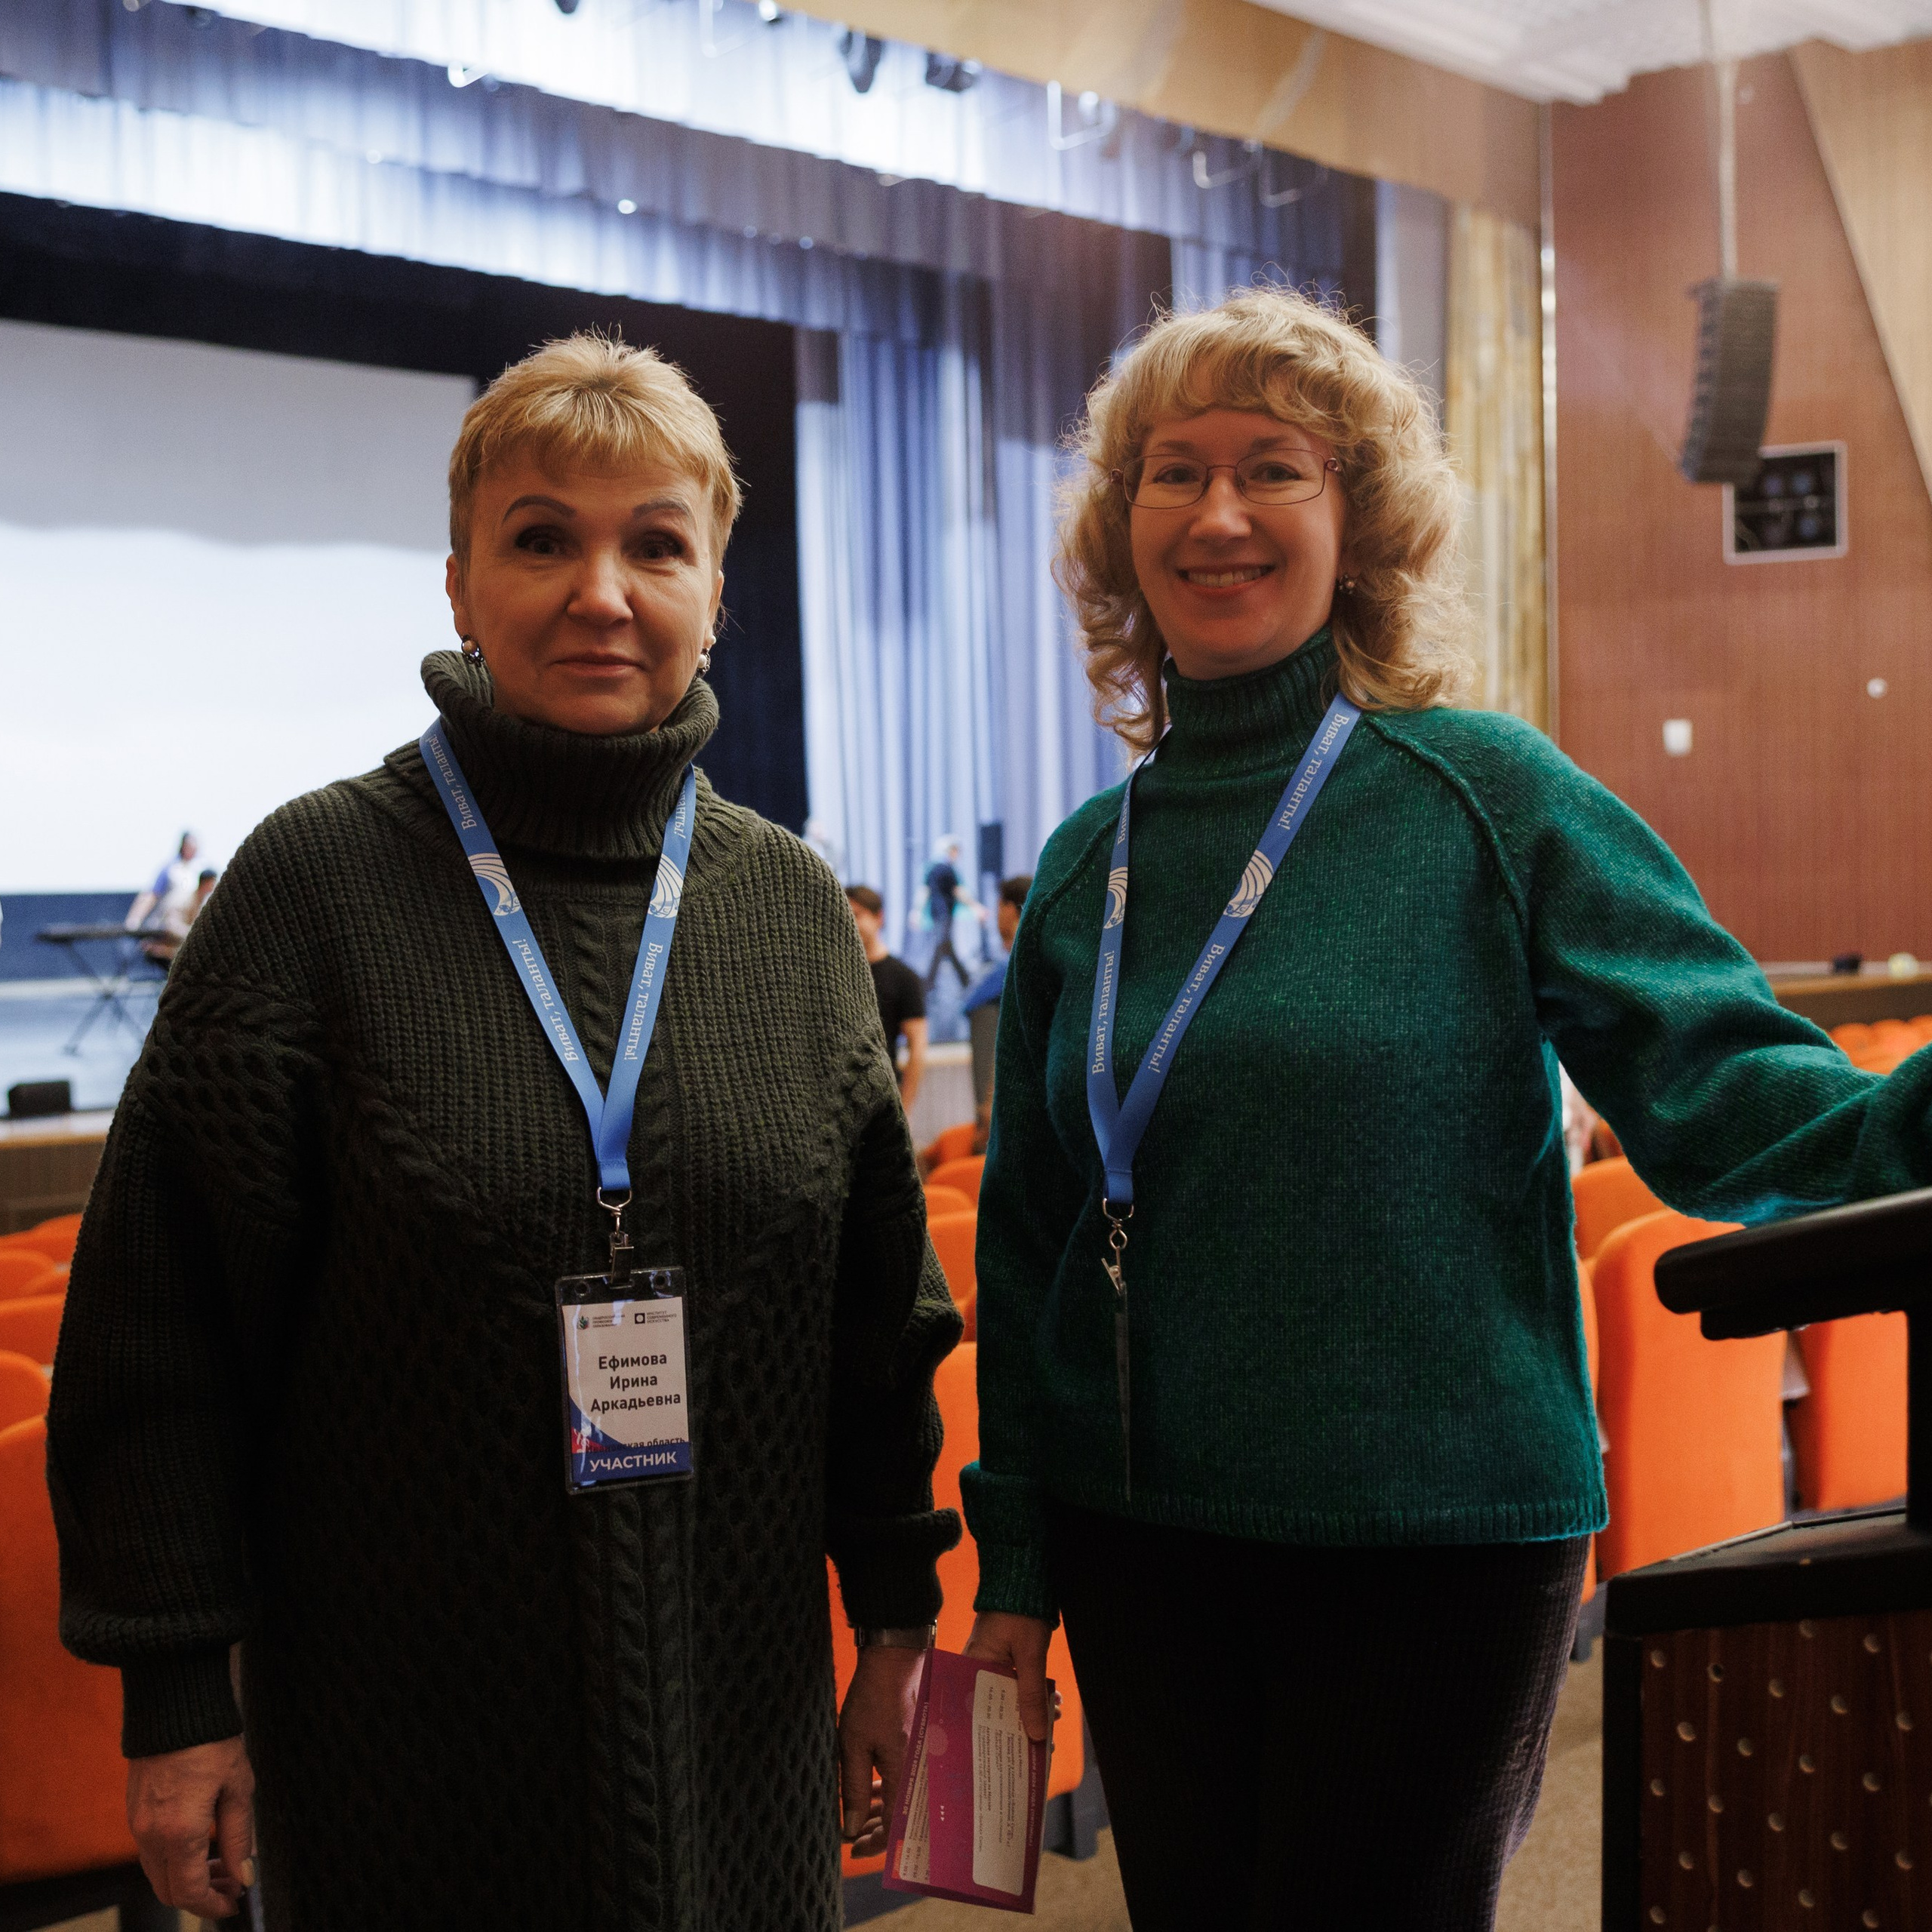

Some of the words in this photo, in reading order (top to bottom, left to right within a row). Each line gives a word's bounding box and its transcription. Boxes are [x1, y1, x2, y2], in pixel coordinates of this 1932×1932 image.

[1314, 713, 1350, 755] Виват,
[451, 783, 477, 830] Виват,
[1277, 759, 1322, 830] таланты!
[512, 938, 555, 1011] таланты!
[638, 942, 663, 990] Виват,
[1099, 950, 1115, 1020] таланты!
[1186, 943, 1225, 995] Виват,
[550, 1011, 579, 1062] Виват,
[623, 992, 649, 1060] таланты!
[1092, 1020, 1108, 1075] Виват,
[1147, 995, 1192, 1073] таланты!
[598, 1354, 667, 1372] Ефимова
[610, 1375, 658, 1392] Ирина
[590, 1393, 681, 1414] Аркадьевна
[589, 1451, 677, 1472] УЧАСТНИК
[647, 1437, 685, 1447] область
